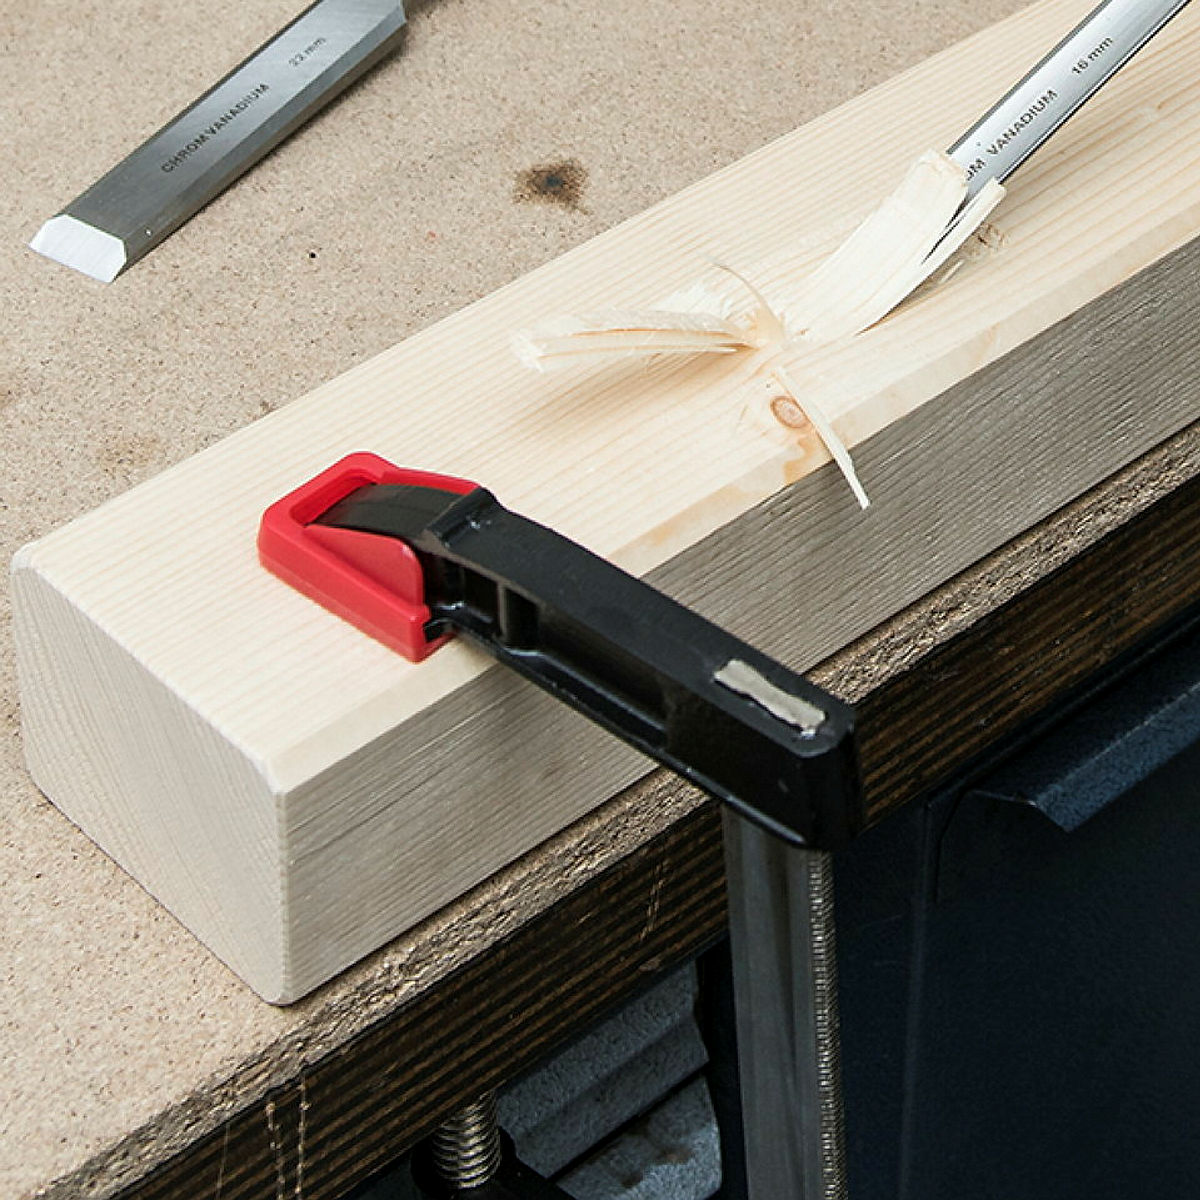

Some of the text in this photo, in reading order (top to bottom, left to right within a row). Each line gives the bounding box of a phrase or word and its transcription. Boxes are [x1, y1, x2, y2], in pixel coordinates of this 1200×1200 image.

[1071, 37, 1114, 75] 16 mm
[986, 89, 1059, 157] VANADIUM
